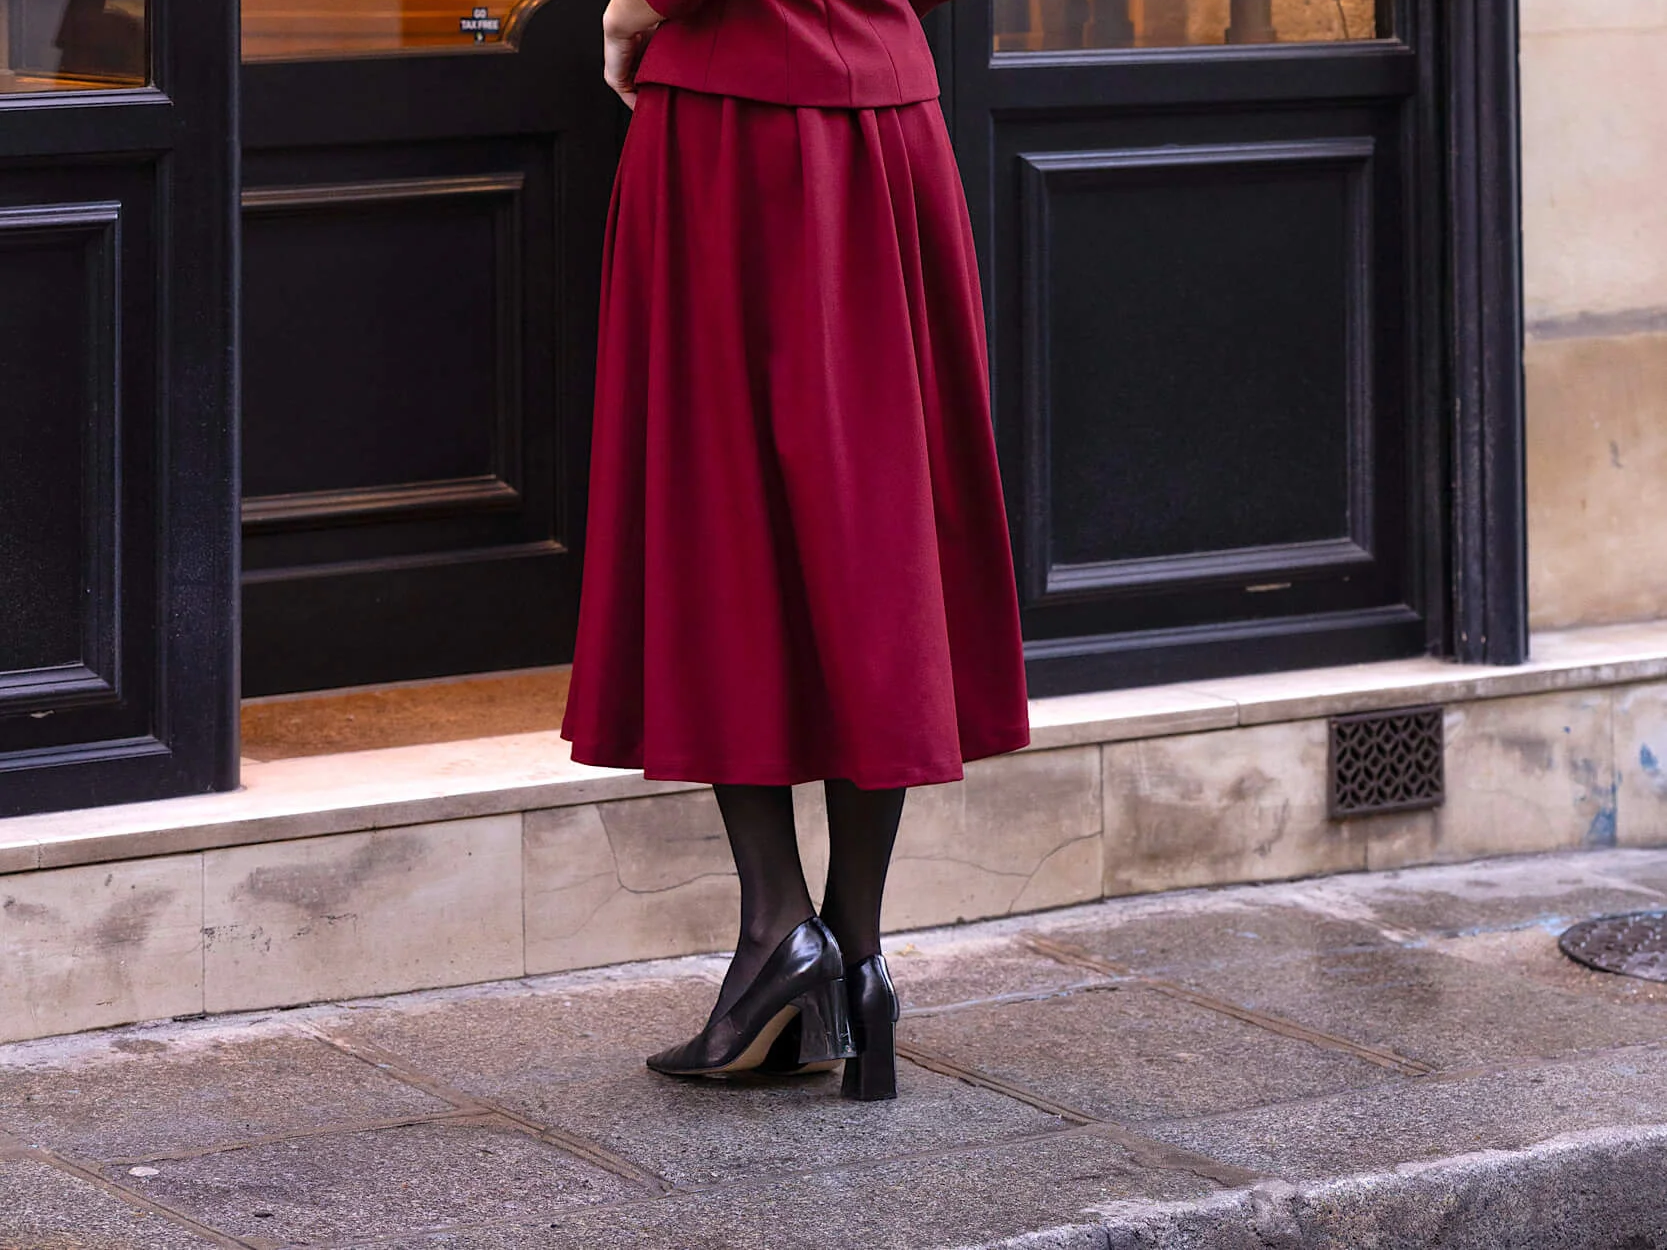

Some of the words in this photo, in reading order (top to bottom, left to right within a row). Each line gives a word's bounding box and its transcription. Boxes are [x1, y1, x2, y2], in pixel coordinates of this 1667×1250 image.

[473, 8, 487, 18] GO
[461, 20, 477, 30] TAX
[478, 20, 499, 30] FREE
